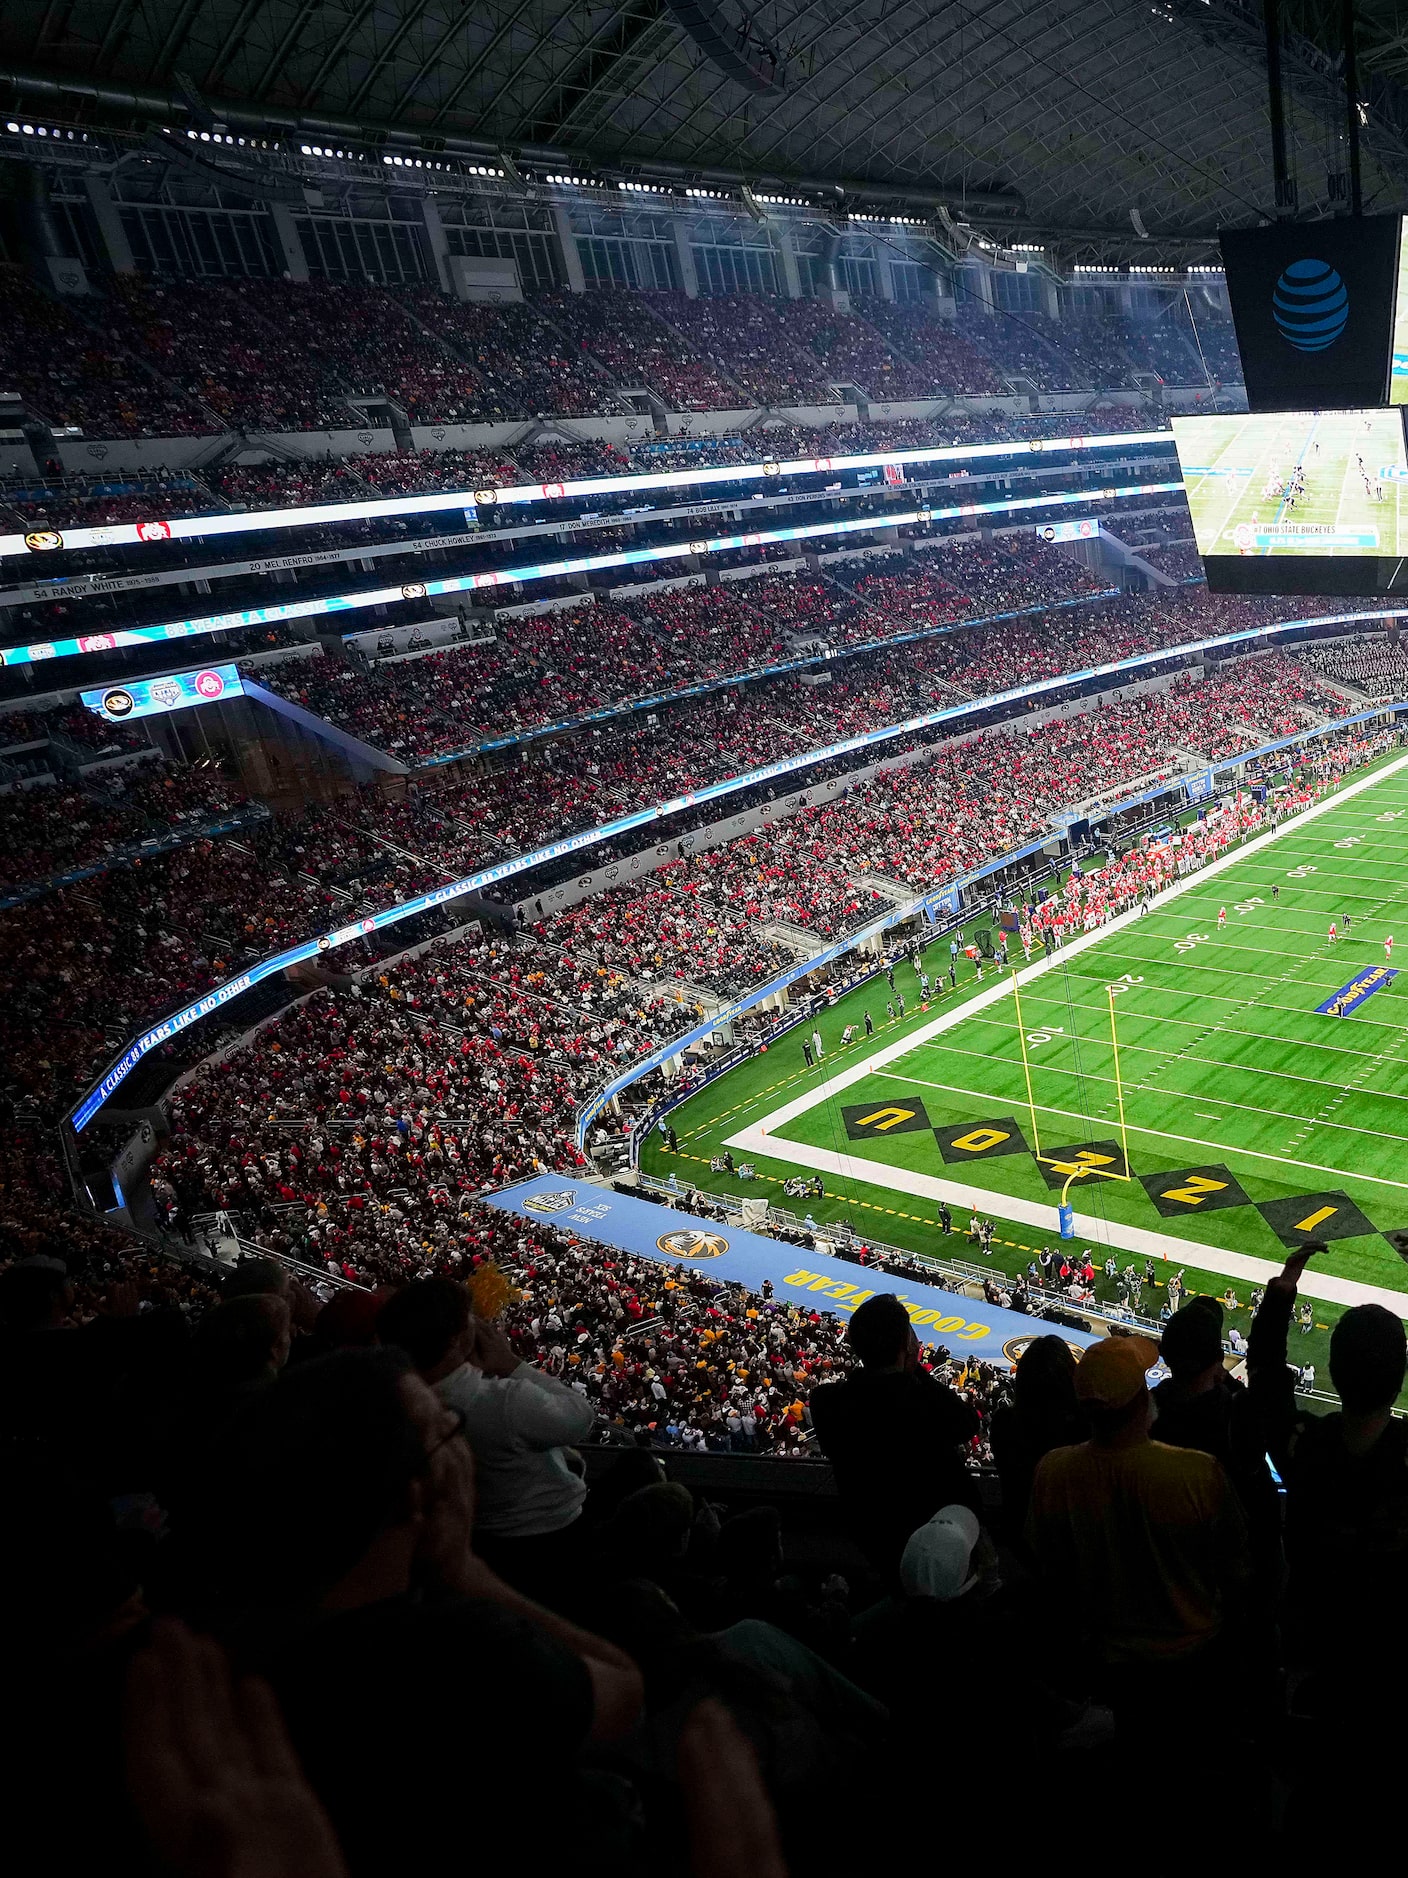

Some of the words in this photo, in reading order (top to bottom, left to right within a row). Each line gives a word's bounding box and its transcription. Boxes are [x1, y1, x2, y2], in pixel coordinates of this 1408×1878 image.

[706, 504, 721, 513] LILLY
[568, 520, 582, 529] DON
[582, 517, 610, 528] MEREDITH
[1280, 525, 1301, 534] STATE
[1301, 525, 1336, 534] BUCKEYES
[424, 538, 447, 548] CHUCK
[447, 535, 474, 545] HOWLEY
[249, 561, 261, 571] 20
[264, 559, 281, 569] MEL
[282, 555, 313, 567] RENFRO
[33, 589, 48, 599] 54
[52, 584, 88, 597] RANDY
[89, 580, 125, 593] WHITE
[166, 619, 187, 637] 88
[193, 615, 243, 631] YEARS
[265, 601, 328, 619] CLASSIC
[1333, 834, 1361, 848] 40
[434, 878, 481, 901] CLASSIC
[481, 871, 494, 885] 88
[494, 860, 528, 878] YEARS
[529, 850, 552, 867] LIKE
[552, 843, 569, 857] NO
[571, 831, 601, 849] OTHER
[1287, 864, 1319, 878] 50
[926, 885, 956, 906] GOODYEAR
[1234, 897, 1265, 911] 40
[1174, 933, 1210, 950] 30
[1105, 974, 1144, 995] 20
[713, 1006, 743, 1026] GOODYEAR
[99, 1087, 109, 1099] A
[107, 1057, 133, 1093] CLASSIC
[131, 1047, 141, 1061] 88
[138, 1024, 173, 1052] YEARS
[172, 1006, 199, 1031] LIKE
[199, 996, 217, 1014] NO
[218, 975, 253, 1003] OTHER
[1026, 1025, 1064, 1043] 10
[575, 1206, 607, 1220] YEARS
[592, 1203, 614, 1212] SIX
[567, 1213, 594, 1224] NEW
